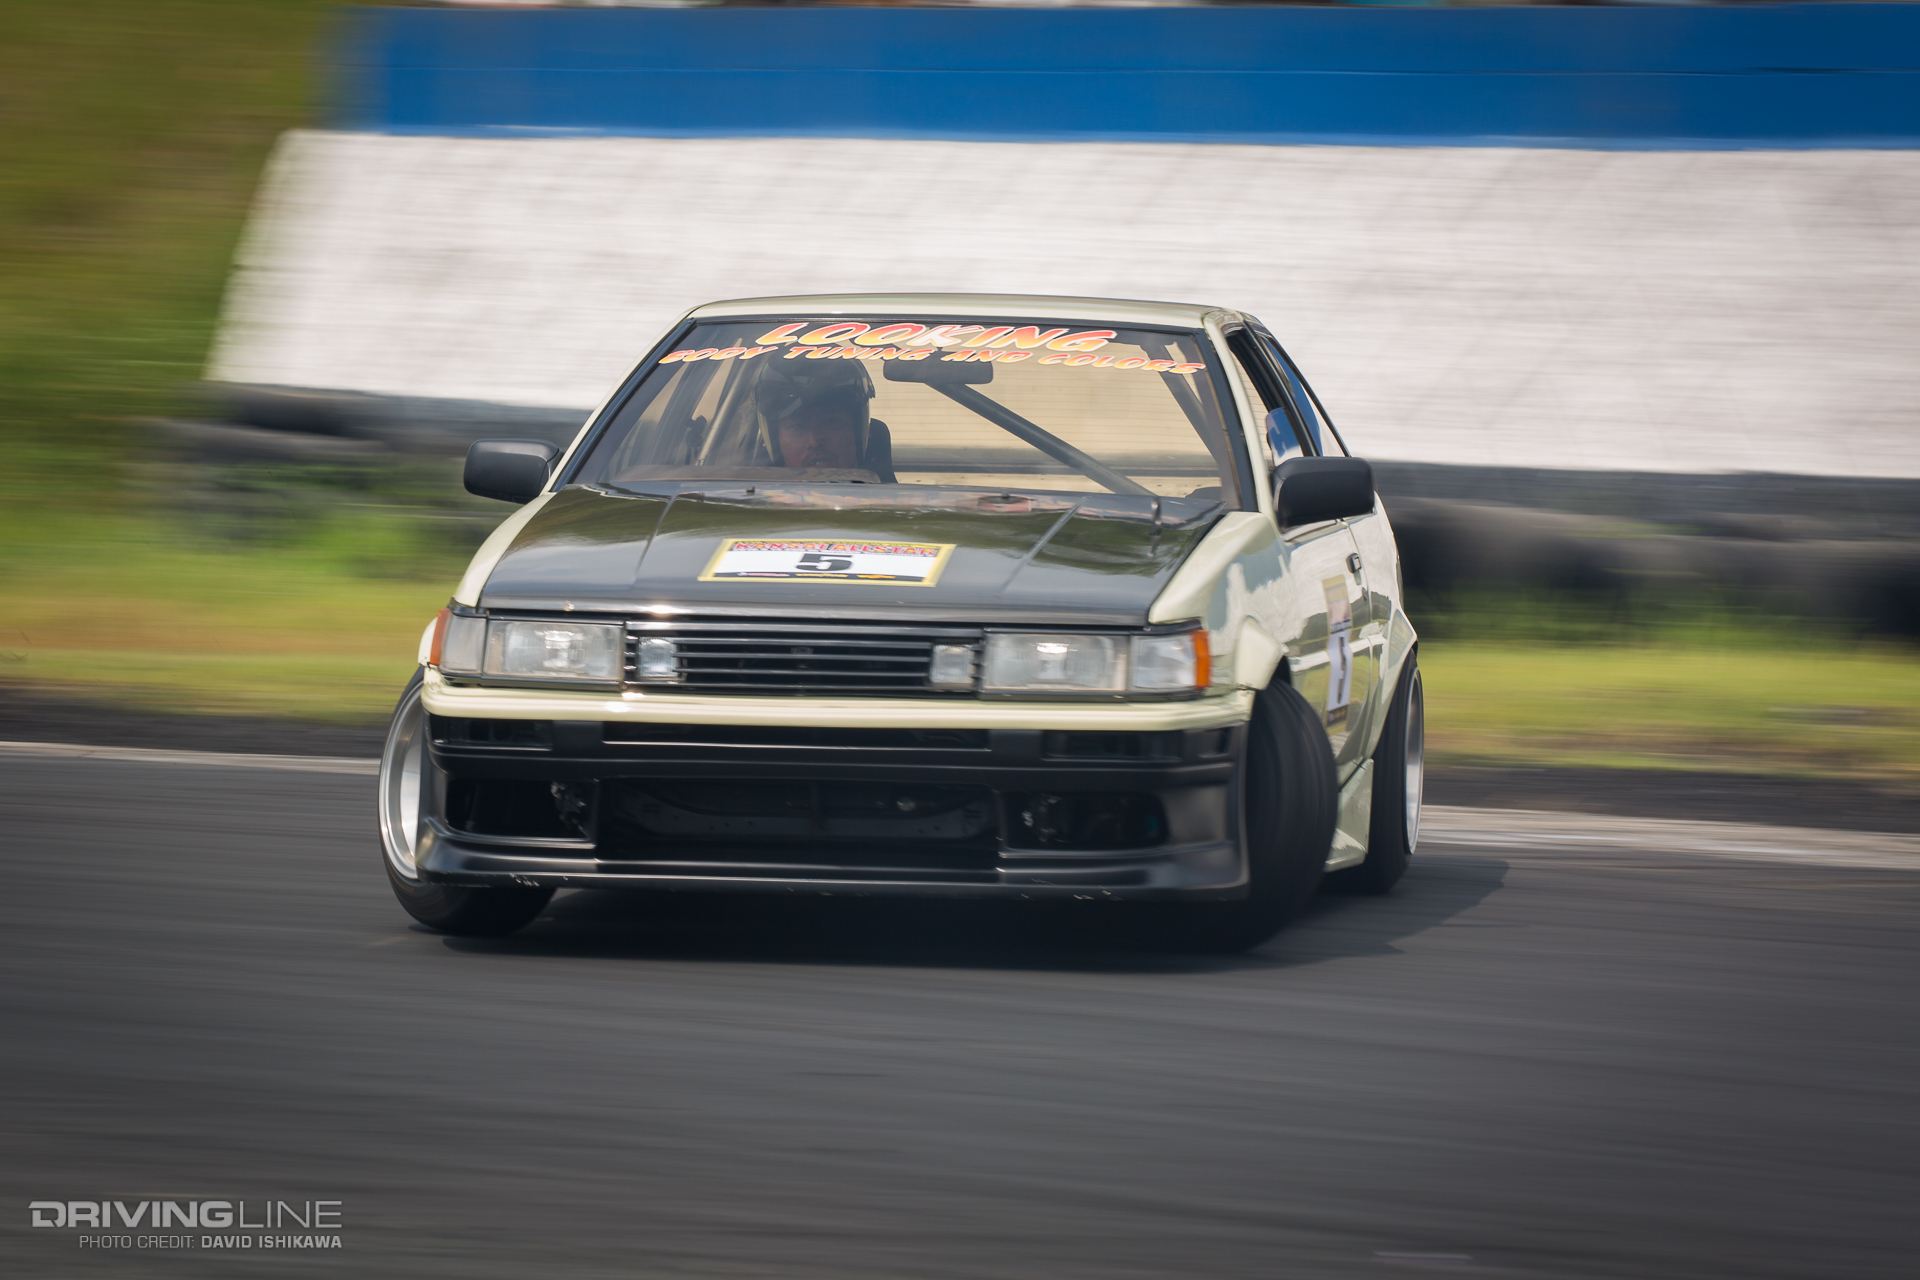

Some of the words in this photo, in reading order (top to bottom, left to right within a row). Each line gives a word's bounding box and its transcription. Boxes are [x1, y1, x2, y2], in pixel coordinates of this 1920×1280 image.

[756, 322, 1117, 352] LOOKING
[658, 345, 778, 364] BODY
[783, 346, 935, 361] TUNING
[941, 349, 1033, 363] AND
[1038, 353, 1206, 374] COLORS
[795, 553, 853, 571] 5
[1336, 636, 1347, 704] 5
